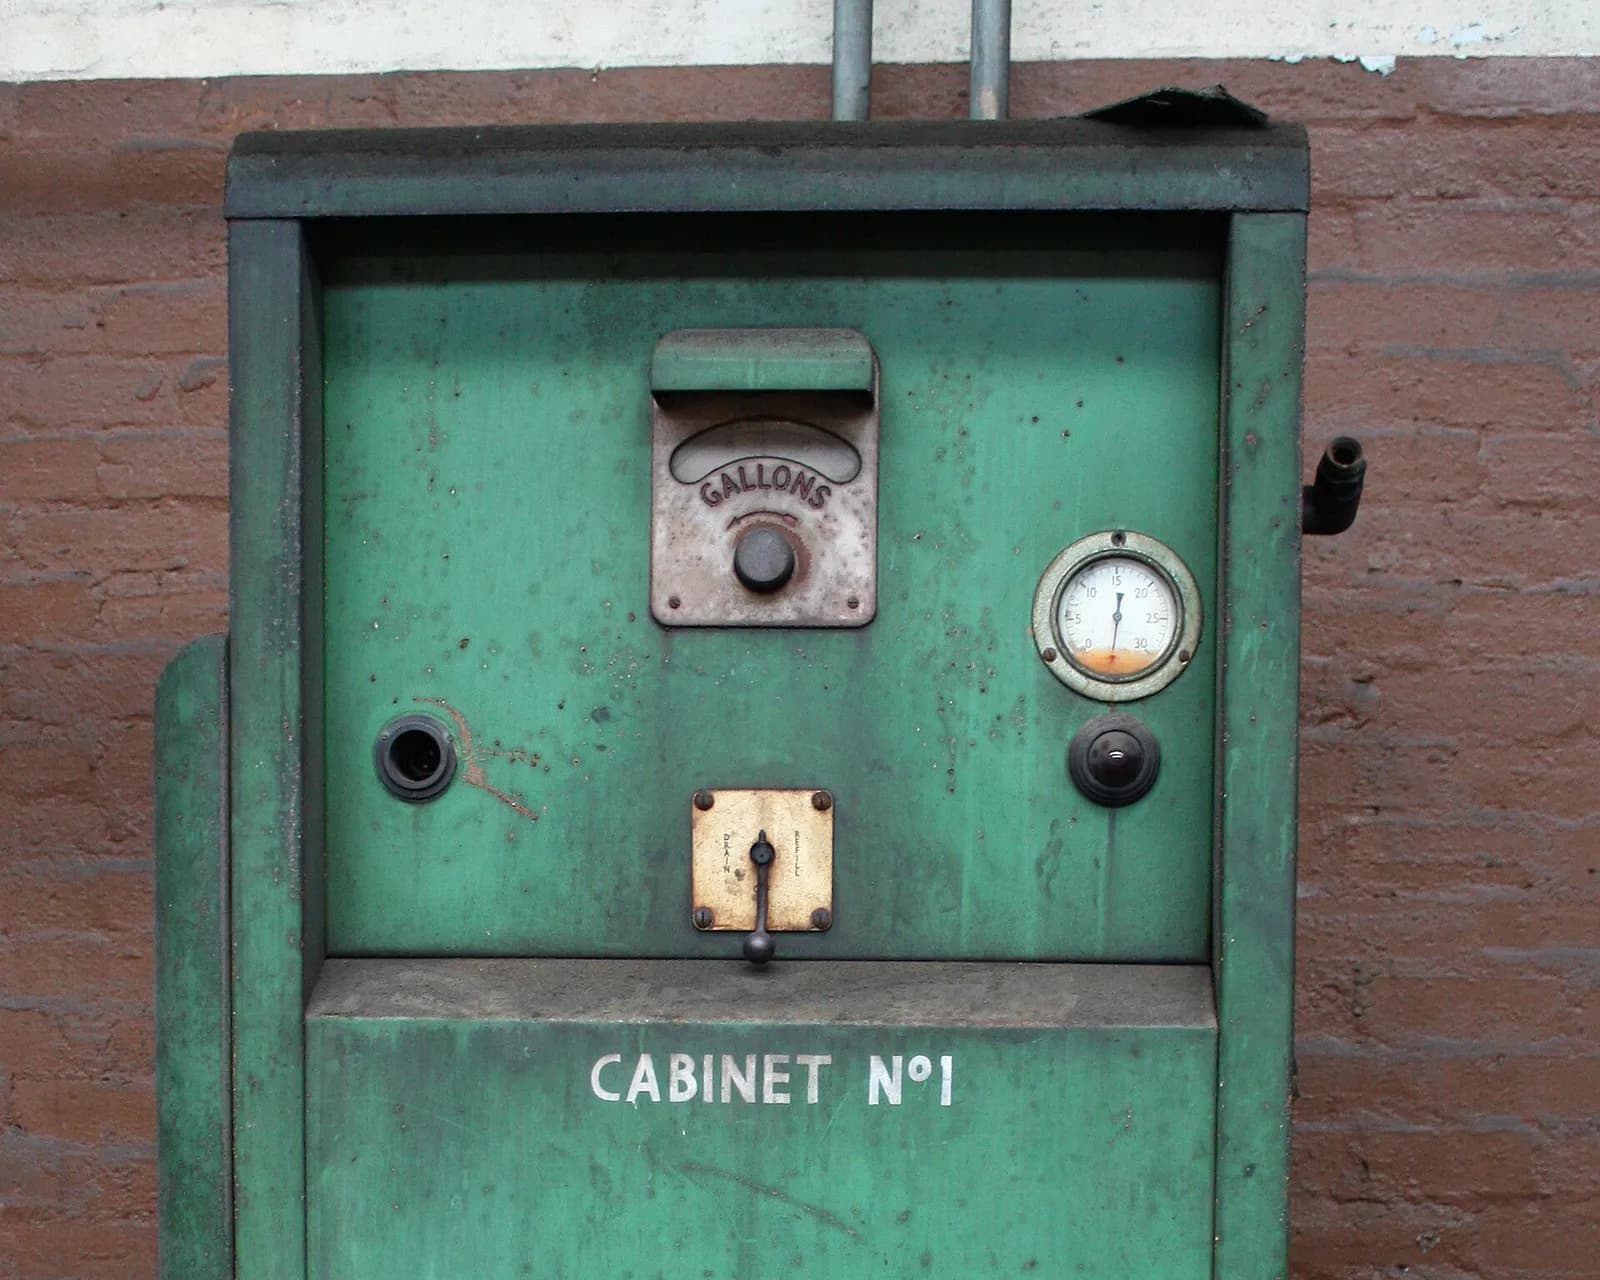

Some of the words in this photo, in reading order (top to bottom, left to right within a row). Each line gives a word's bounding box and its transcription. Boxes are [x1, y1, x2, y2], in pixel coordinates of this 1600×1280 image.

[700, 464, 831, 508] GALLONS
[1112, 575, 1121, 586] 15
[1086, 587, 1096, 598] 10
[1134, 587, 1148, 598] 20
[1075, 613, 1081, 624] 5
[1145, 613, 1160, 624] 25
[1085, 638, 1092, 648] 0
[1135, 638, 1147, 648] 30
[590, 1053, 832, 1105] CABINET
